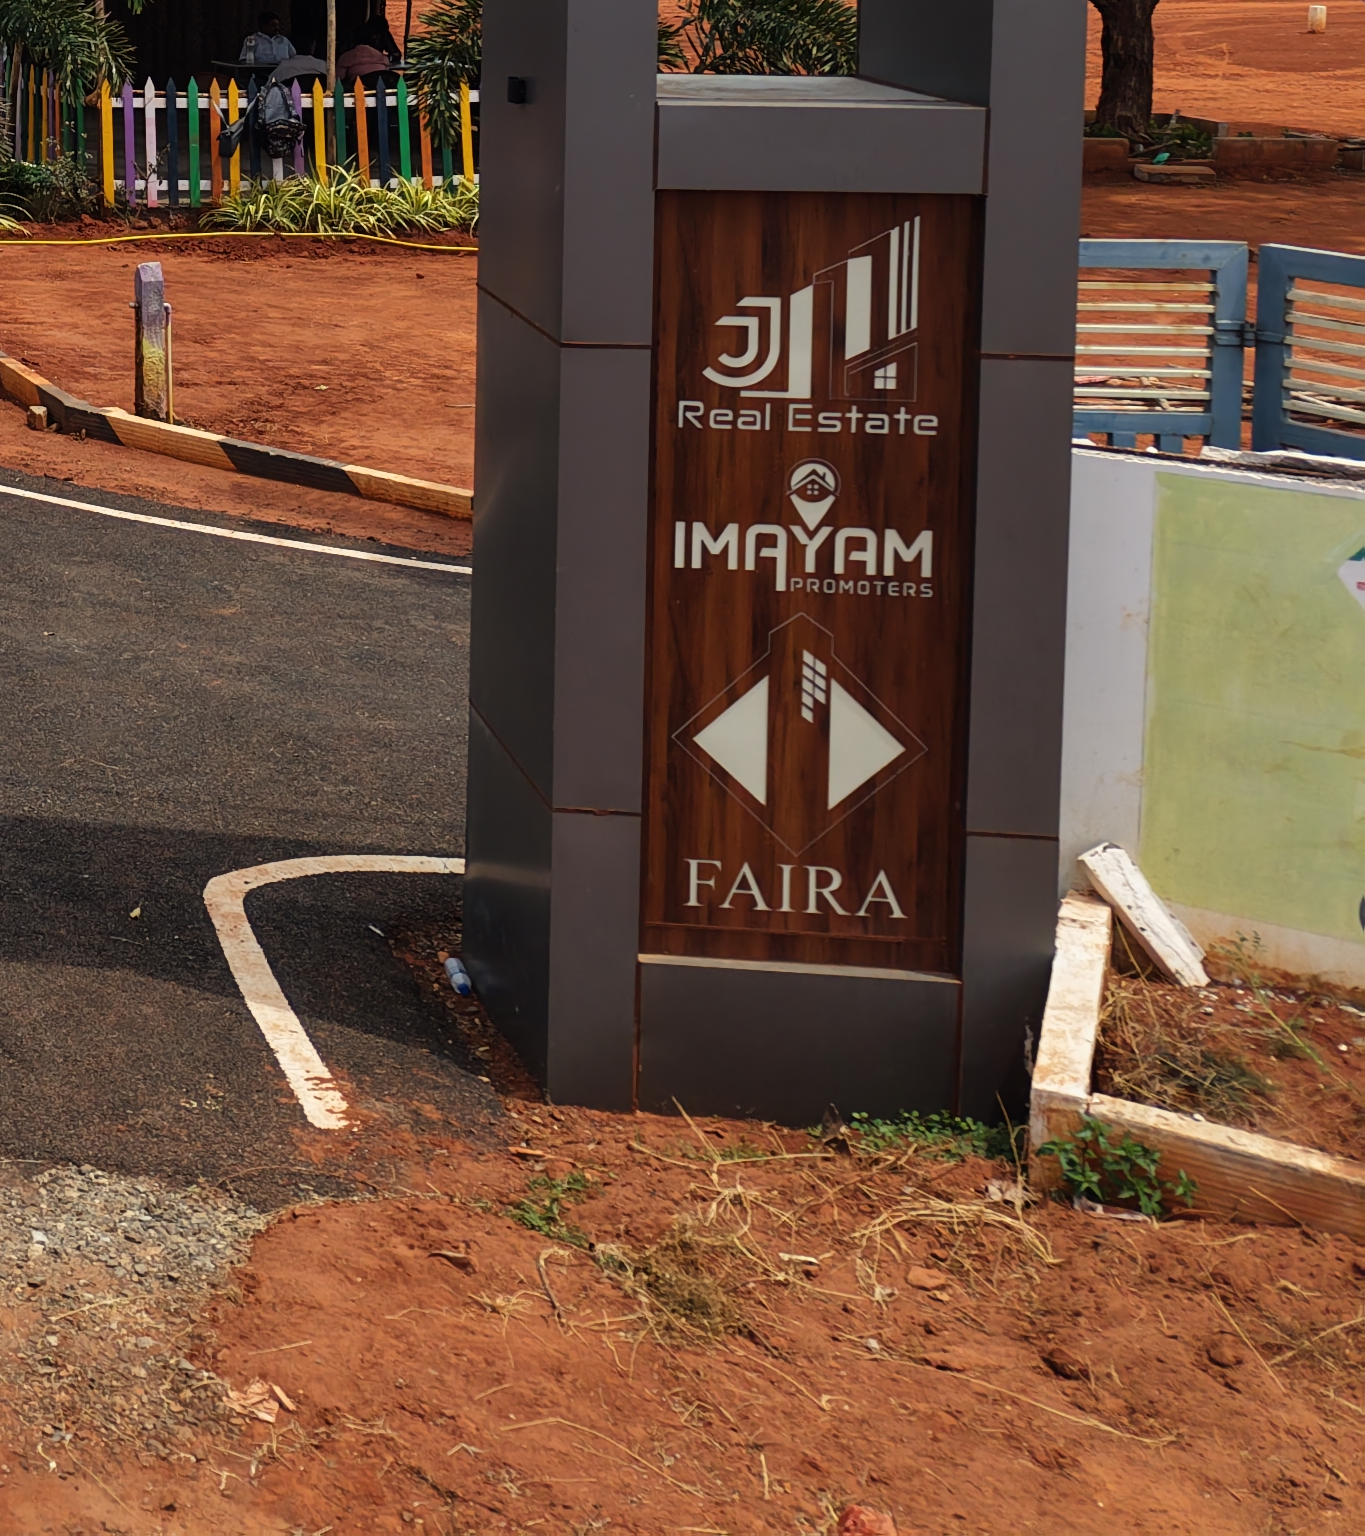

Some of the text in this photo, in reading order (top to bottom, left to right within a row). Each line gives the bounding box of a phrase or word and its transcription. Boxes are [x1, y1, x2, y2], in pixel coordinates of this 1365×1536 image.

[678, 400, 939, 436] Real Estate
[674, 521, 933, 592] IMAYAM
[790, 577, 934, 598] PROMOTERS
[683, 858, 909, 919] FAIRA
